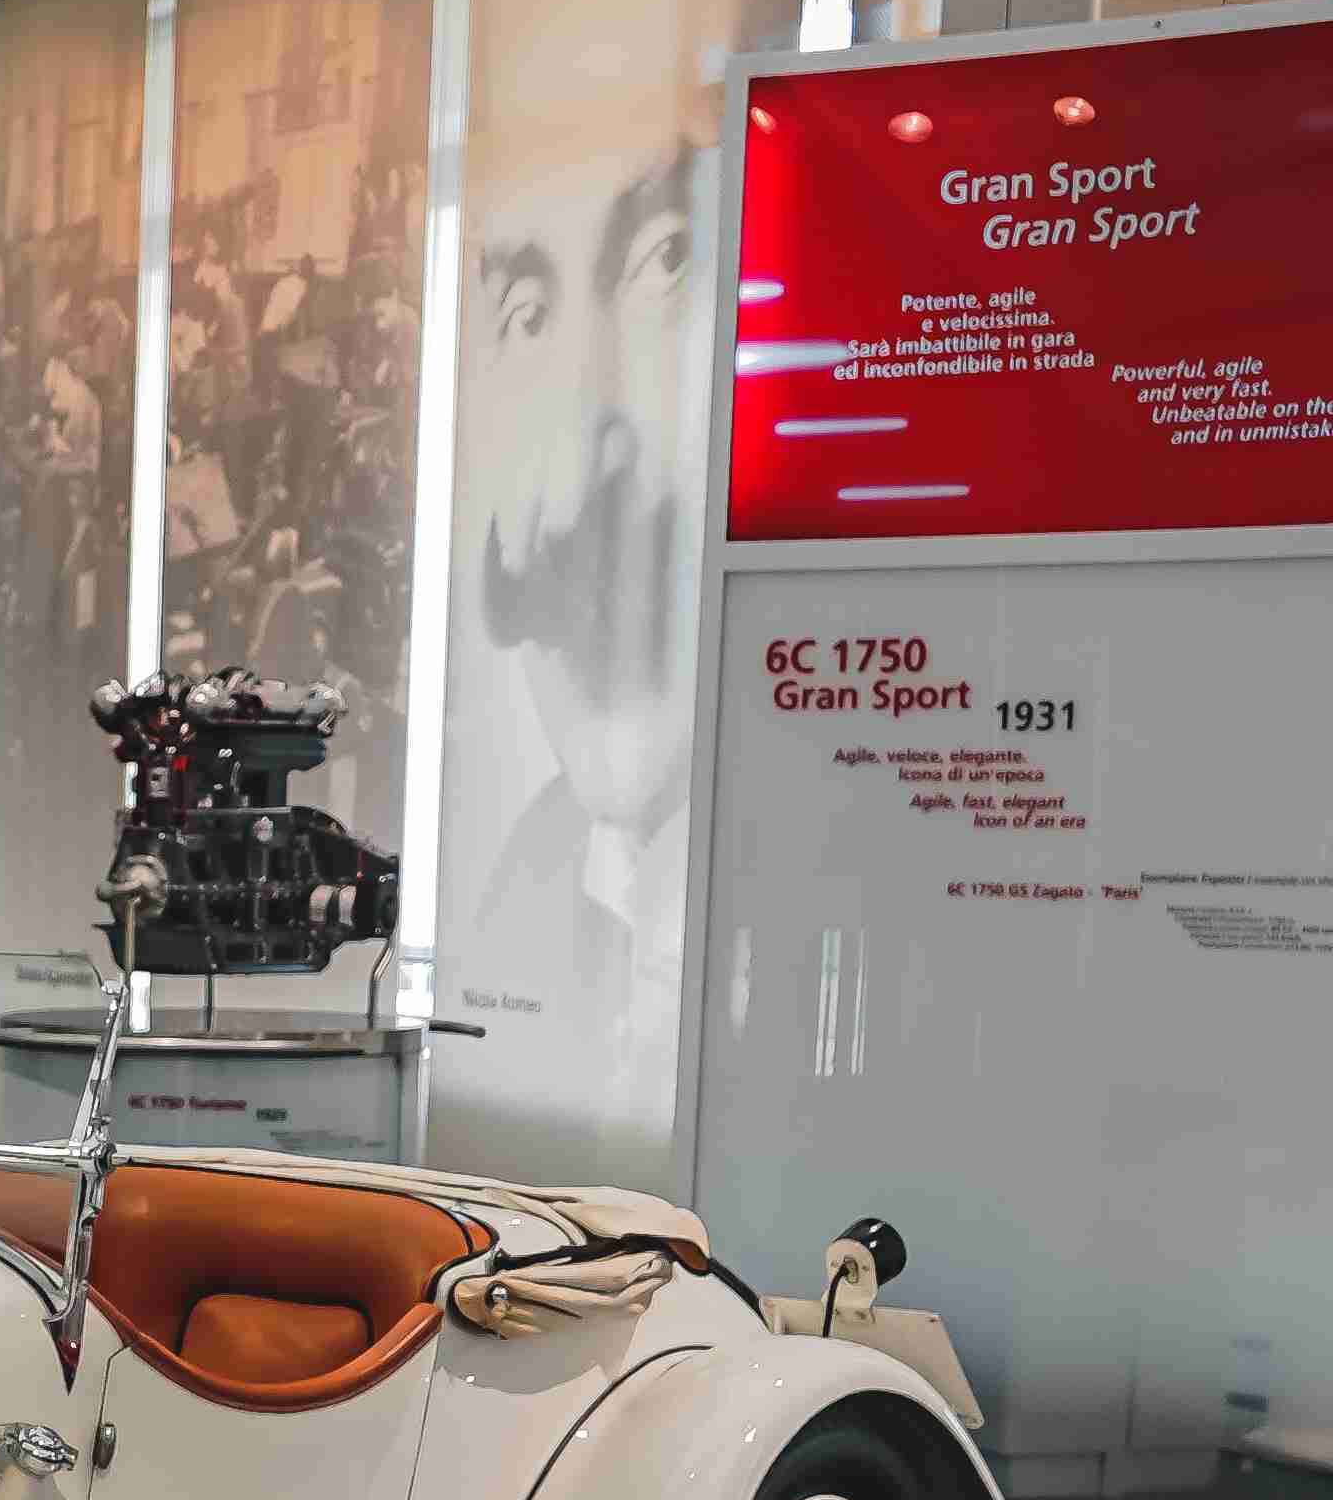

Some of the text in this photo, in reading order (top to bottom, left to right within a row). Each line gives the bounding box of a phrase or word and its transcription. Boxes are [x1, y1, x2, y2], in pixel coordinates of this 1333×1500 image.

[940, 157, 1156, 204] Gran Sport
[983, 201, 1200, 250] Gran Sport
[988, 287, 1036, 311] agile
[921, 310, 1055, 332] e velocissima.
[847, 331, 1076, 358] Sarà imbattibile in gara
[834, 350, 1094, 380] ed inconfondibile in strada
[1213, 356, 1263, 380] agile
[1137, 379, 1272, 404] and very fast.
[1152, 401, 1267, 424] Unbeatable
[1273, 403, 1298, 418] on
[1171, 418, 1333, 444] and in unmistak
[766, 637, 927, 673] 6C 1750
[774, 679, 972, 718] Gran Sport
[996, 700, 1074, 731] 1931
[833, 746, 880, 766] Agile,
[947, 767, 963, 782] di
[1003, 794, 1065, 813] elegant
[1013, 811, 1034, 829] of
[1035, 817, 1054, 828] an
[1060, 817, 1086, 829] era
